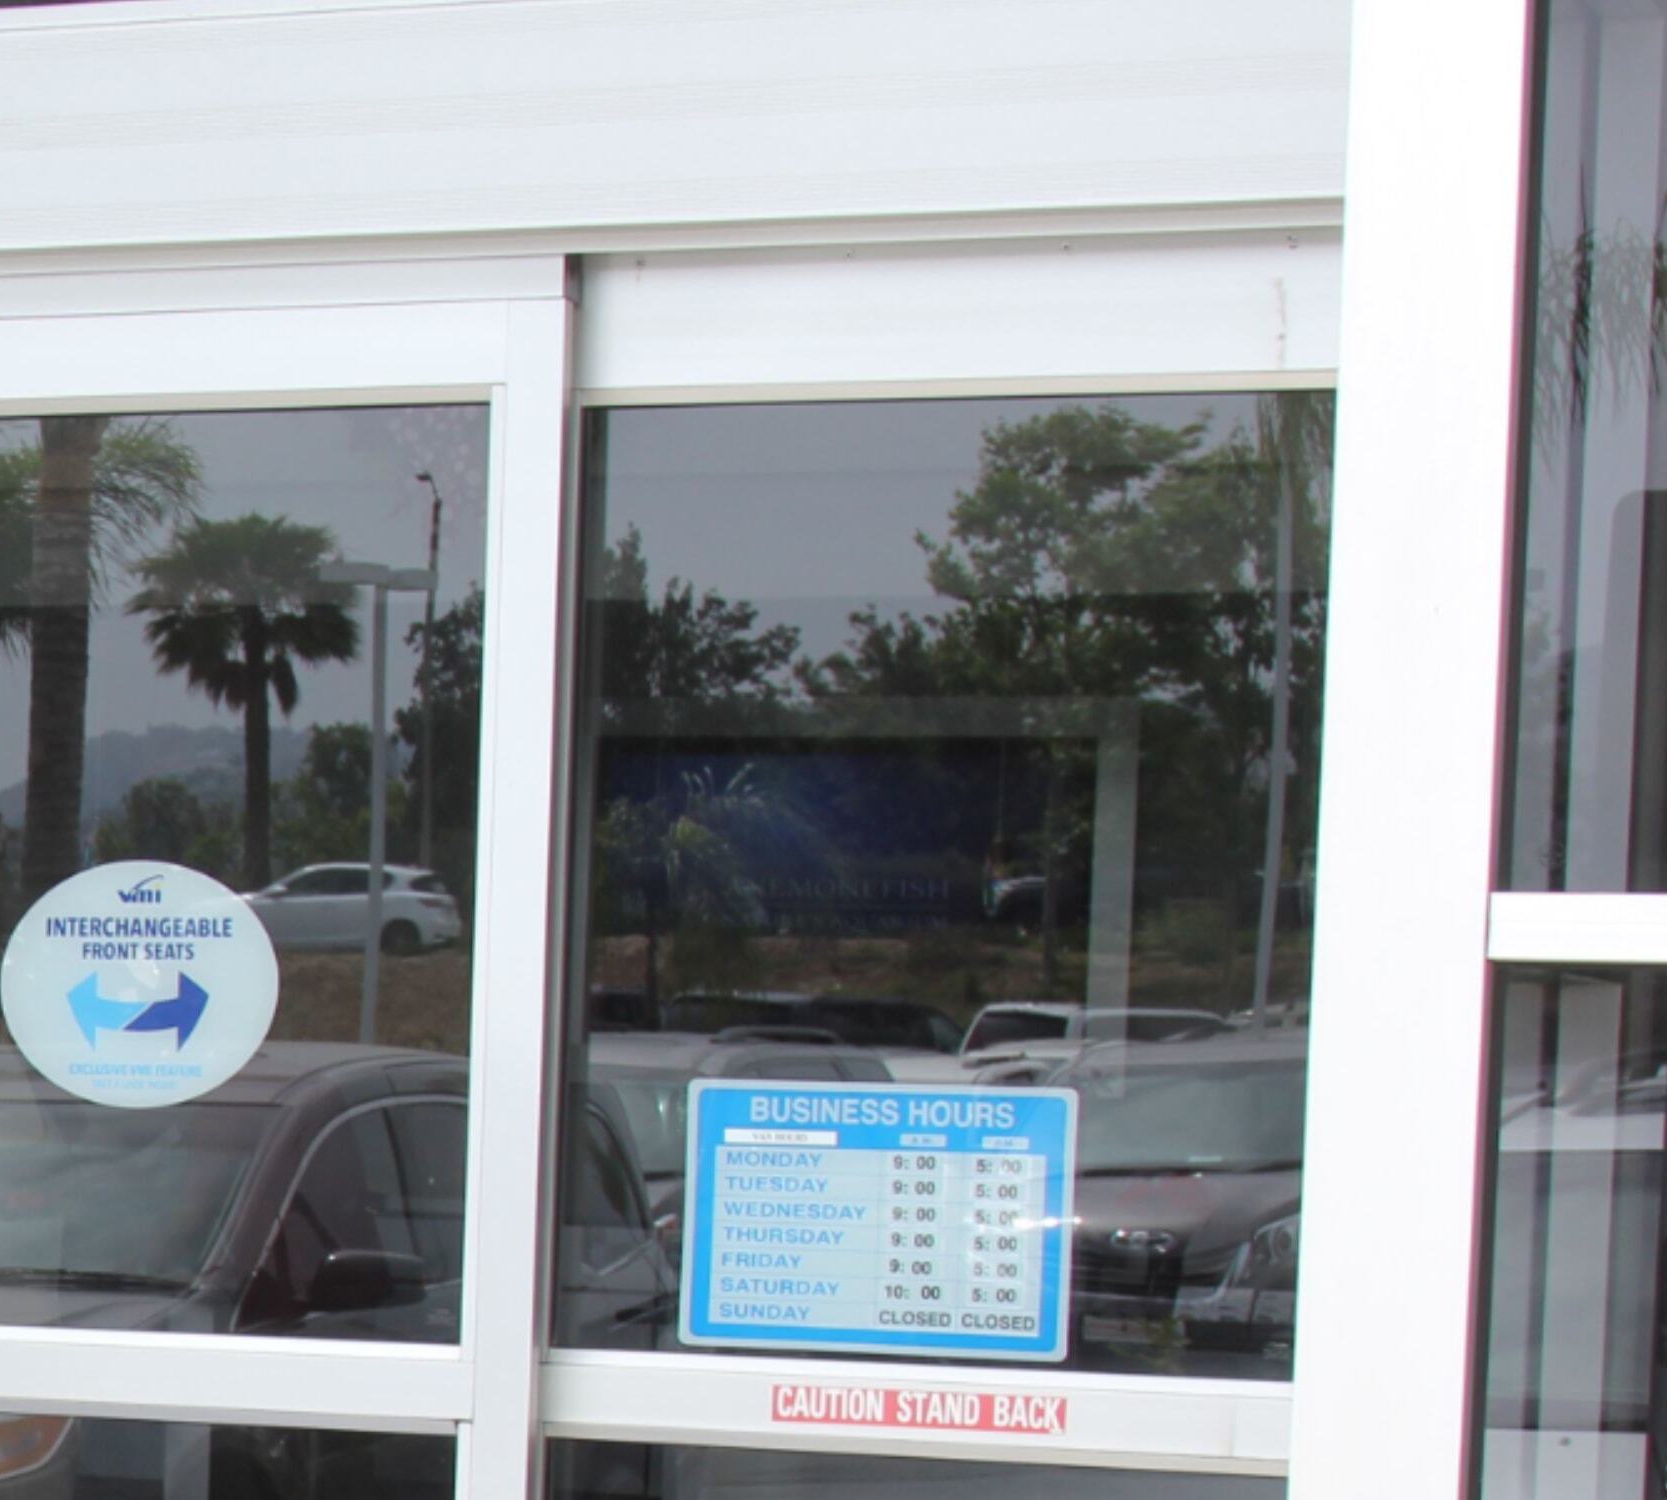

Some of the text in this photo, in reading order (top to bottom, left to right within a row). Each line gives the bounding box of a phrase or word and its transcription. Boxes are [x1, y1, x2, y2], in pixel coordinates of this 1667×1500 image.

[45, 917, 233, 938] INTERCHANGEABLE
[82, 943, 195, 961] FRONT SEATS
[749, 1096, 1016, 1128] BUSINESS HOURS
[727, 1152, 822, 1168] MONDAY
[725, 1177, 828, 1193] TUESDAY
[725, 1202, 866, 1220] WEDNESDAY
[724, 1227, 844, 1245] THURSDAY
[722, 1253, 801, 1269] FRIDAY
[721, 1277, 840, 1296] SATURDAY
[720, 1303, 1036, 1331] SUNDAY CLOSED CLOSED
[778, 1388, 1062, 1432] CAUTION STAND BACK
